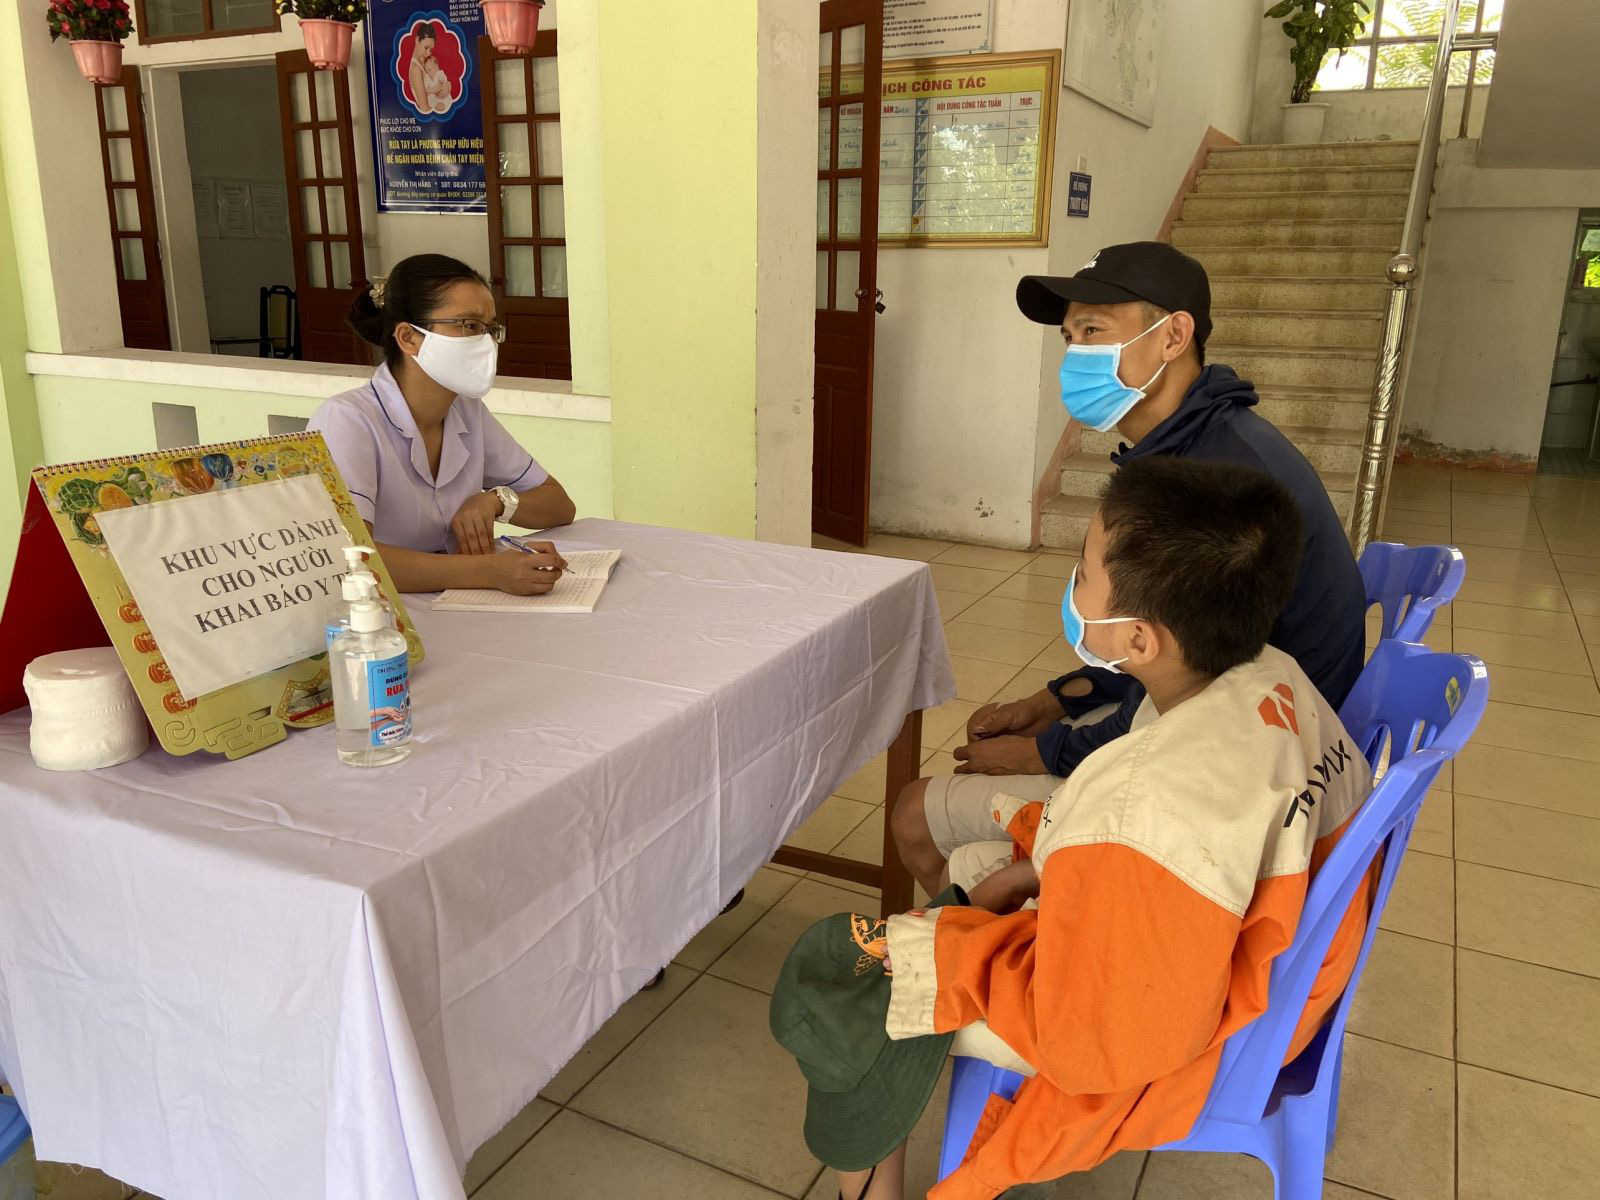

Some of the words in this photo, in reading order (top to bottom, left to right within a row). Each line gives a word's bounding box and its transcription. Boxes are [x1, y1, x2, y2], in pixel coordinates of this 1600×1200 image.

[882, 82, 907, 96] ỊCH
[911, 78, 952, 92] CÔNG
[958, 75, 986, 90] TÁC
[400, 140, 410, 149] TAY
[411, 138, 418, 149] LÀ
[442, 138, 457, 149] PHÁP
[458, 154, 468, 163] TAY
[469, 152, 484, 165] MIỆN
[160, 546, 219, 575] KHU
[220, 532, 276, 560] VỰC
[277, 518, 339, 546] DÀNH
[201, 568, 256, 597] CHO
[258, 546, 334, 582] NGƯỜI
[194, 598, 263, 634] KHAI
[266, 584, 313, 612] BÁO
[314, 578, 330, 596] Y
